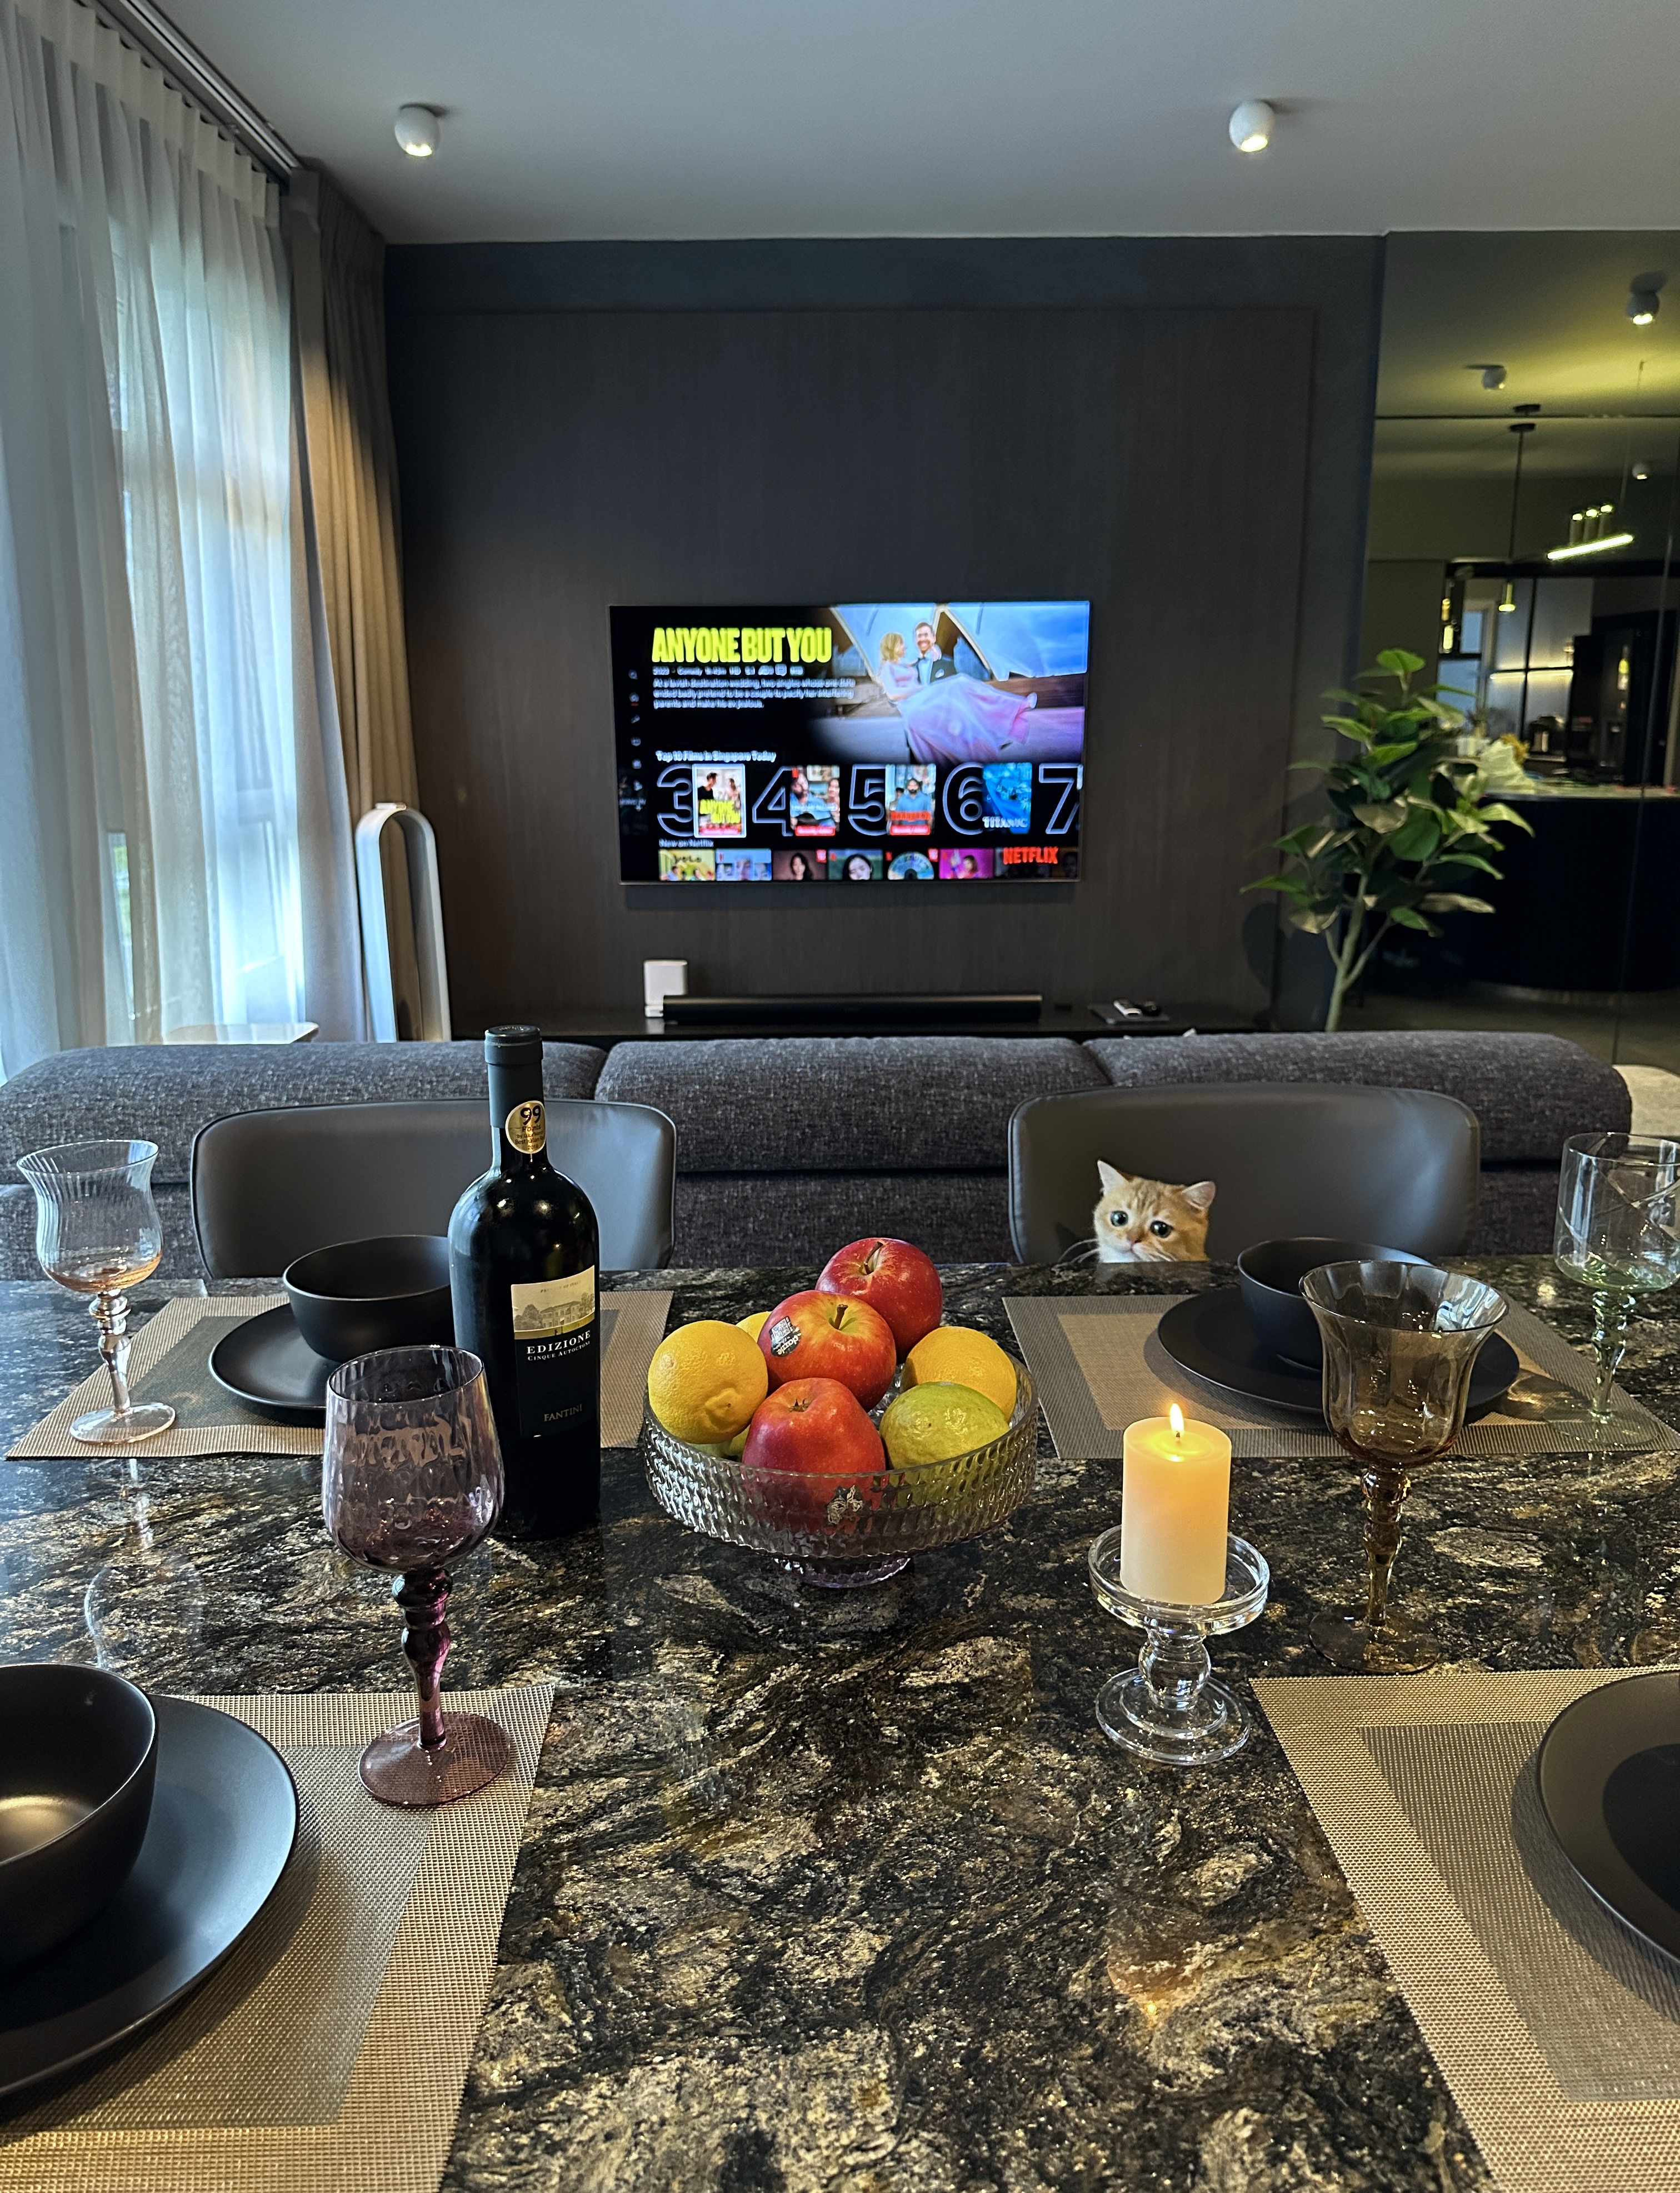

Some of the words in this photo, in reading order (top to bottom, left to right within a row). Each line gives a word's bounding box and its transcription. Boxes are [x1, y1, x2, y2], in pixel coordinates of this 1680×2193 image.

[652, 628, 741, 663] ANYONE
[741, 628, 786, 663] BUT
[786, 628, 832, 663] YOU
[656, 750, 673, 763] Top
[673, 750, 683, 761] 10
[683, 750, 703, 761] Films
[712, 750, 751, 763] Singapore
[751, 750, 776, 763] Today
[657, 763, 693, 837] 3
[752, 765, 793, 837] 4
[848, 764, 889, 836] 5
[943, 762, 983, 835] 6
[1039, 763, 1081, 834] 7
[982, 816, 1028, 828] TITANIC
[659, 839, 677, 848] New
[678, 839, 688, 848] on
[688, 839, 714, 848] Netflix
[1003, 847, 1058, 864] NETFLIX
[520, 1105, 541, 1125] 99
[526, 1330, 591, 1354] EDIZIONE
[558, 1341, 590, 1356] AUTOCTONI
[543, 1404, 583, 1421] FANTINI
